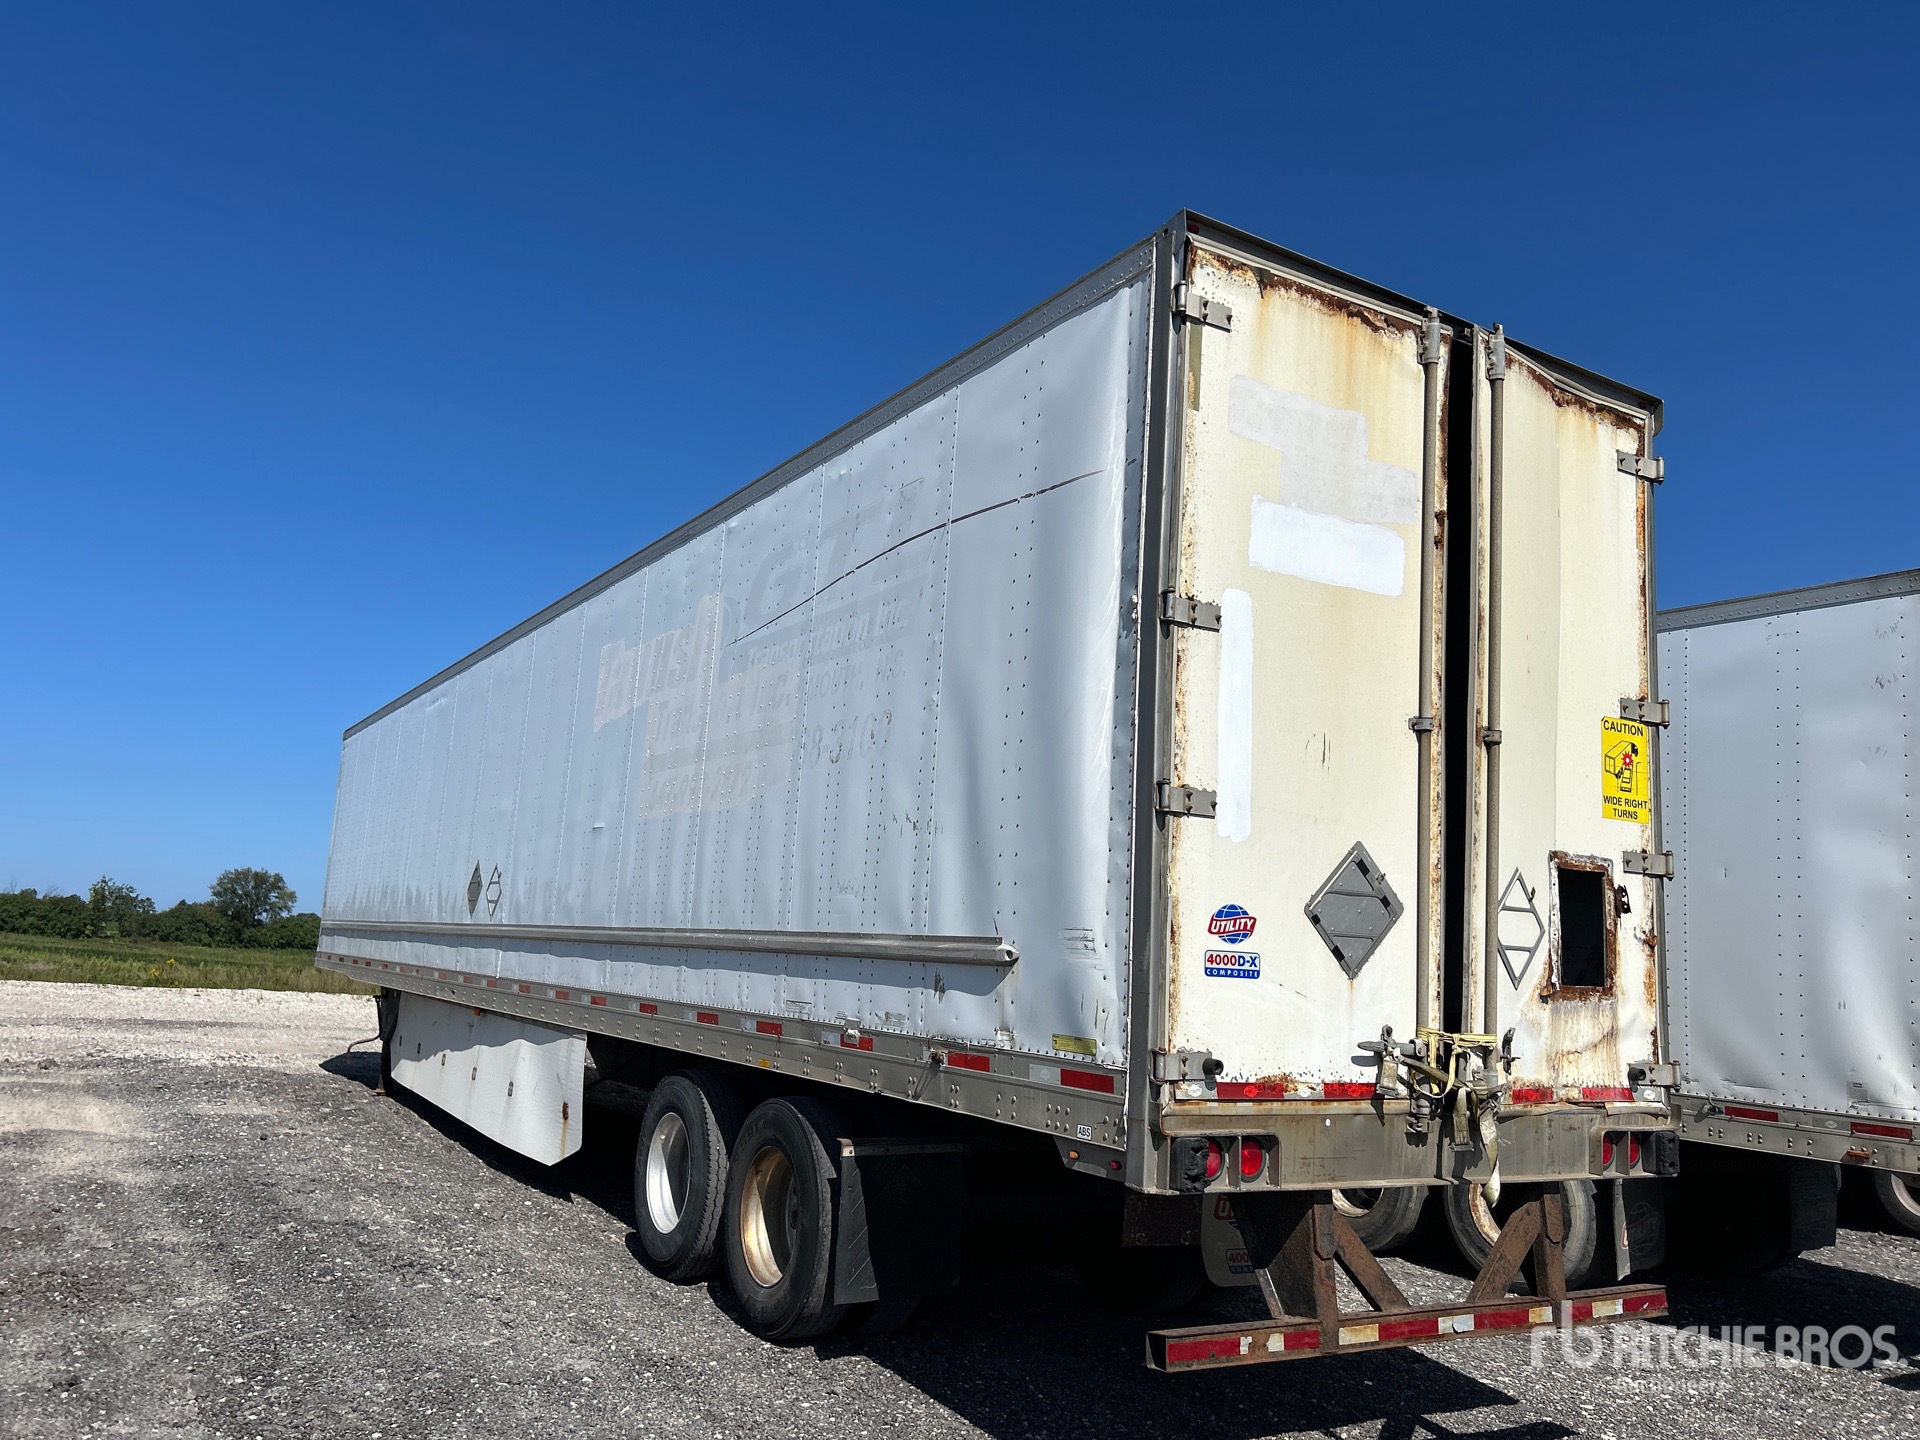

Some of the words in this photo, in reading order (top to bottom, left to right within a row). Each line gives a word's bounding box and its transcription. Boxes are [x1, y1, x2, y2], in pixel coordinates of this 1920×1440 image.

[1603, 720, 1644, 737] CAUTION
[1603, 795, 1623, 807] WIDE
[1624, 798, 1648, 810] RIGHT
[1613, 808, 1638, 820] TURNS
[1211, 918, 1254, 933] UTILITY
[1207, 954, 1258, 968] 4000D-X
[1207, 969, 1258, 978] COMPOSITE
[1078, 1126, 1091, 1138] ABS
